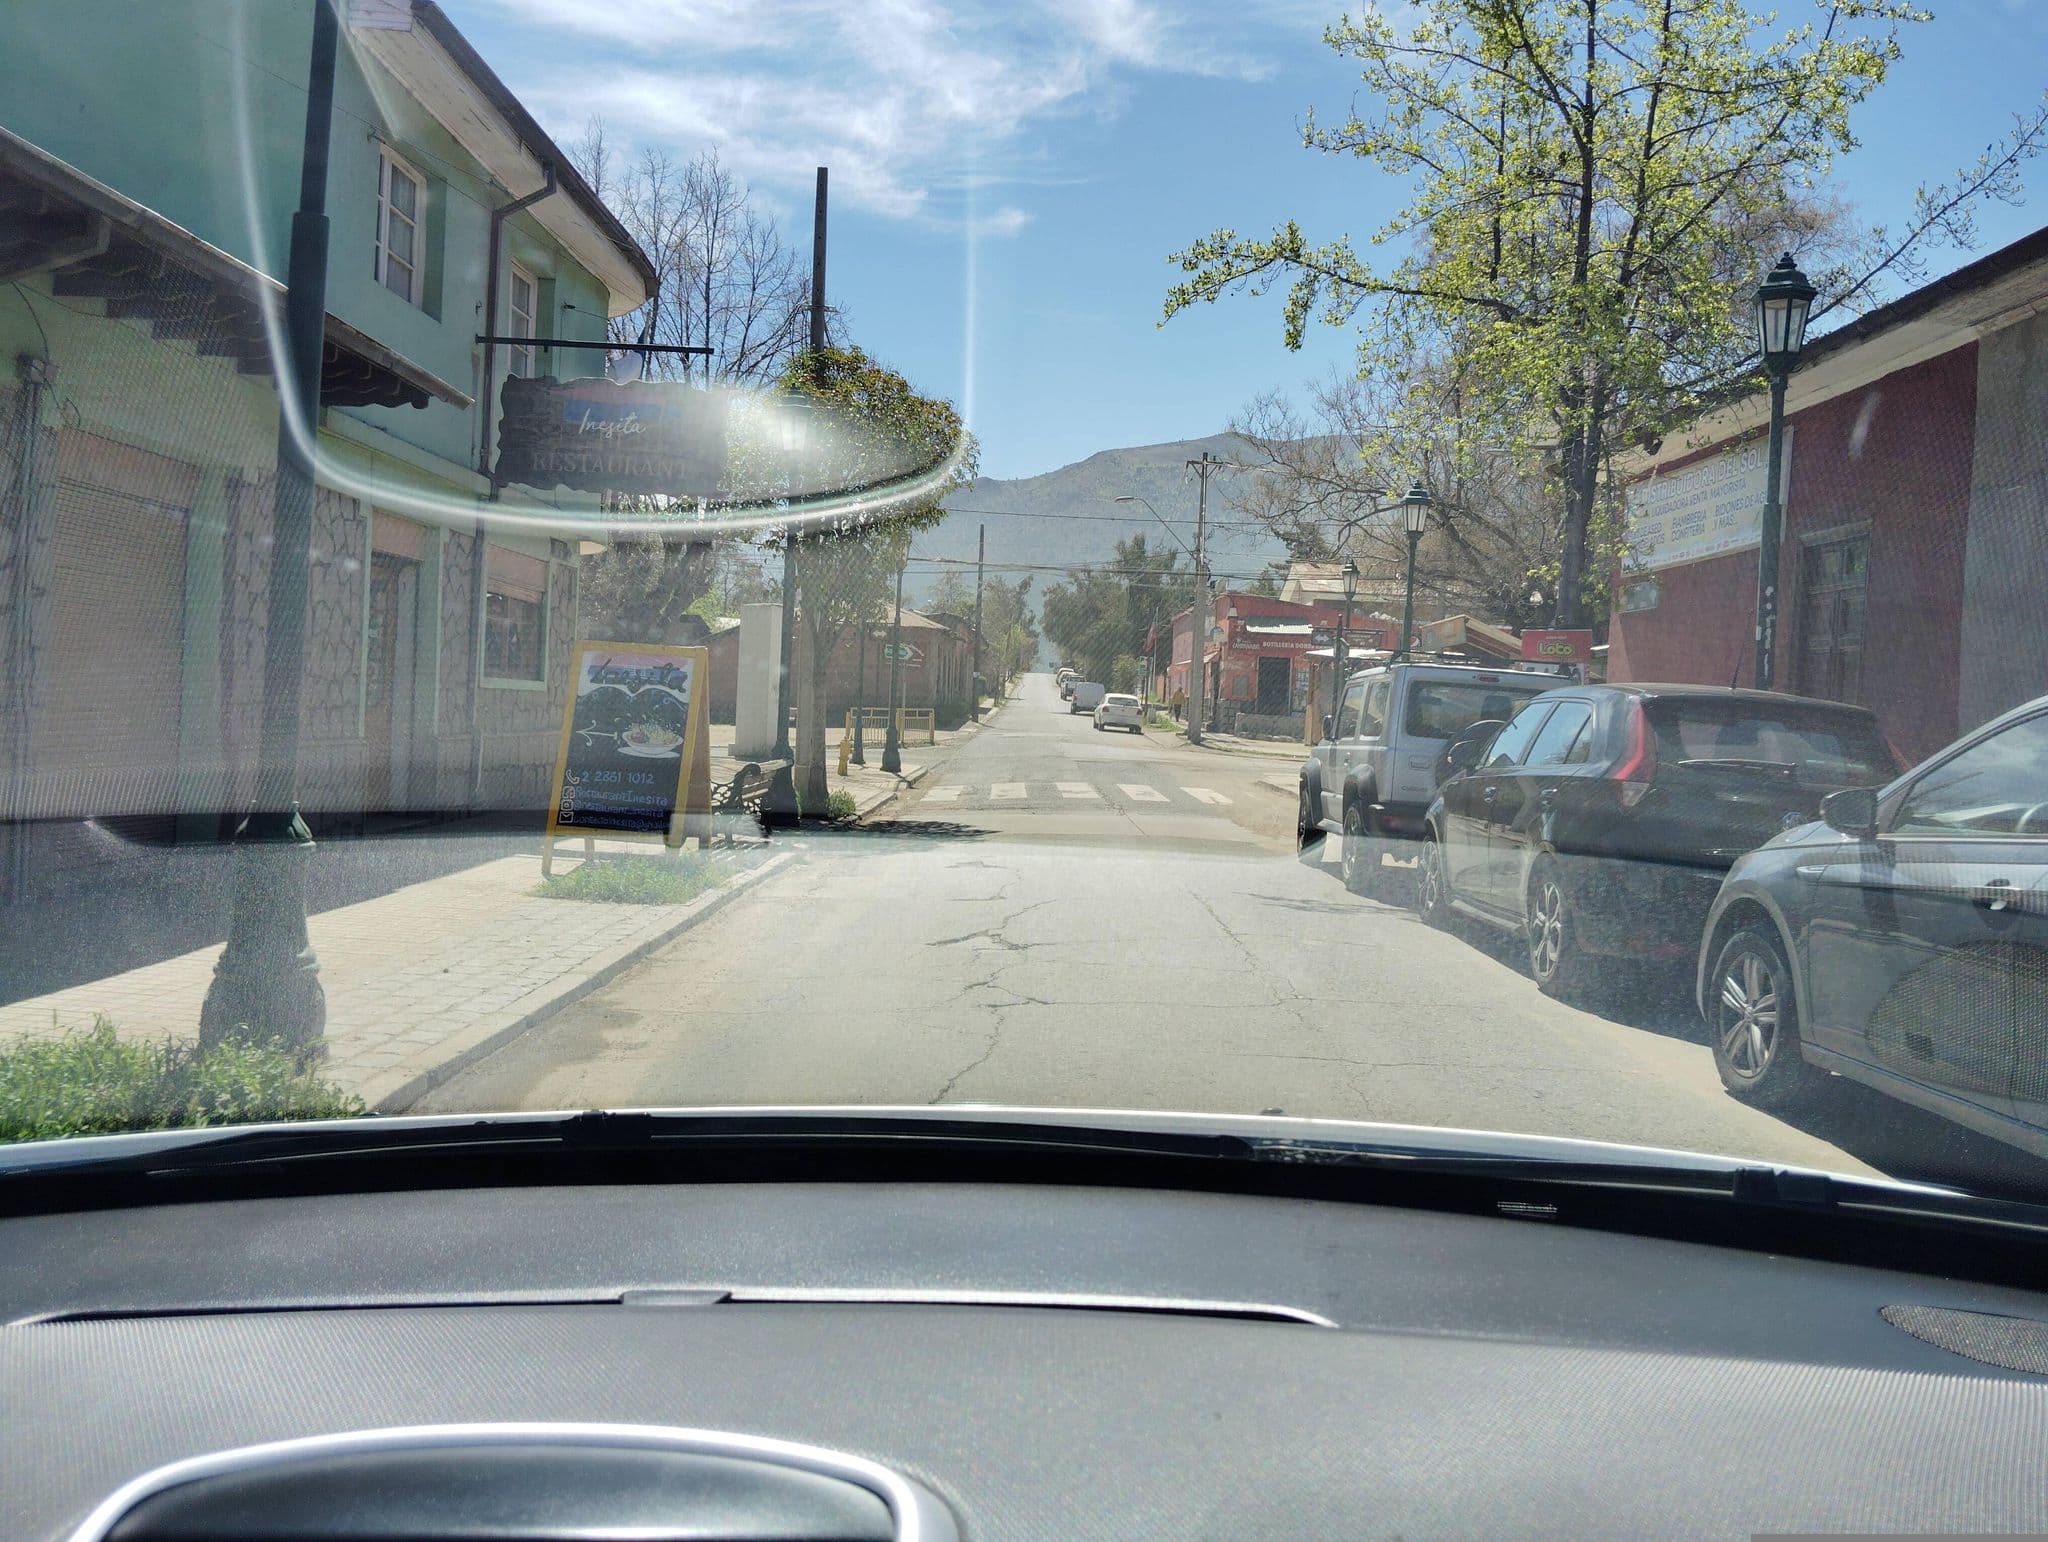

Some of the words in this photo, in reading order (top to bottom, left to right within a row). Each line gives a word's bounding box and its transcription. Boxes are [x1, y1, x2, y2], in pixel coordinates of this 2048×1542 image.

[578, 407, 646, 439] Inesita
[532, 452, 691, 477] RESTAURANT
[1719, 457, 1740, 480] DEL
[1740, 447, 1764, 474] SOL
[1538, 641, 1574, 656] Loto
[581, 771, 590, 783] 2
[595, 771, 622, 783] 2861
[627, 773, 655, 785] 1012
